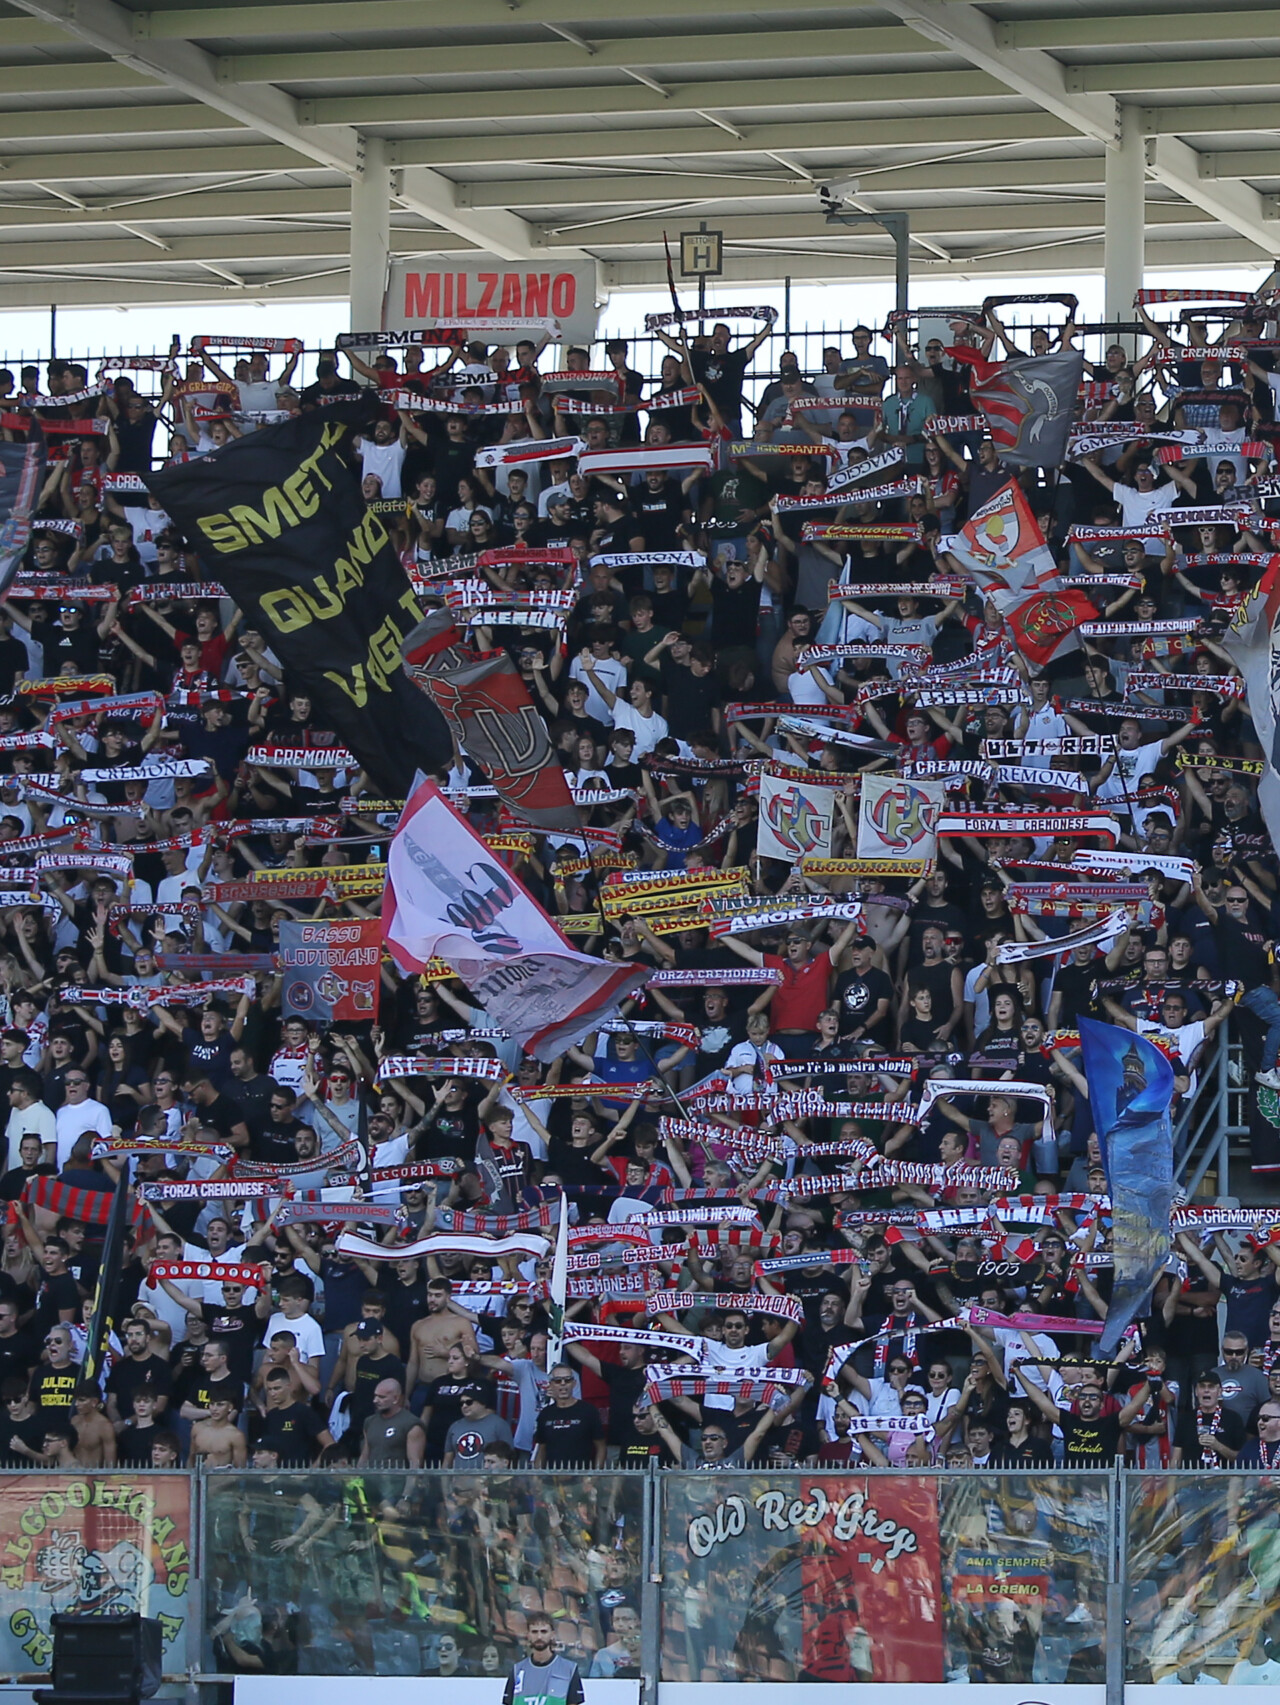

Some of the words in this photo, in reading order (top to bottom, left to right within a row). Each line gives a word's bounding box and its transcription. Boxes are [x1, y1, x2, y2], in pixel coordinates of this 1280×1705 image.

[694, 247, 710, 268] H
[405, 272, 576, 318] MILZANO
[340, 329, 463, 348] CREMONA
[1182, 443, 1241, 455] CREMONA
[601, 551, 695, 567] CREMONA
[836, 644, 909, 657] CREMONESE
[95, 760, 193, 781] CREMONA
[916, 760, 993, 779] CREMONA
[965, 817, 1001, 831] FORZA
[1023, 817, 1089, 831] CREMONESE
[302, 926, 362, 943] BASSO
[285, 946, 379, 967] LODIGIANO
[698, 968, 776, 981] CREMONESE
[453, 1057, 502, 1079] 1903
[839, 1060, 877, 1073] nostra
[880, 1058, 913, 1071] storia
[163, 1184, 199, 1198] FORZA
[201, 1182, 264, 1197] CREMONESE
[293, 1205, 317, 1216] U.S.
[322, 1203, 390, 1217] Cremonese
[1175, 1211, 1202, 1226] U.S.
[976, 1260, 1021, 1276] 1903
[569, 1276, 643, 1293] CREMONESE
[648, 1293, 693, 1314] SOLO
[688, 1495, 746, 1558] Old
[755, 1488, 826, 1532] Red
[833, 1492, 918, 1560] Grey
[966, 1557, 994, 1567] AMA
[996, 1557, 1046, 1568] SEMPRE
[966, 1583, 986, 1595] LA
[988, 1583, 1040, 1596] CREMO
